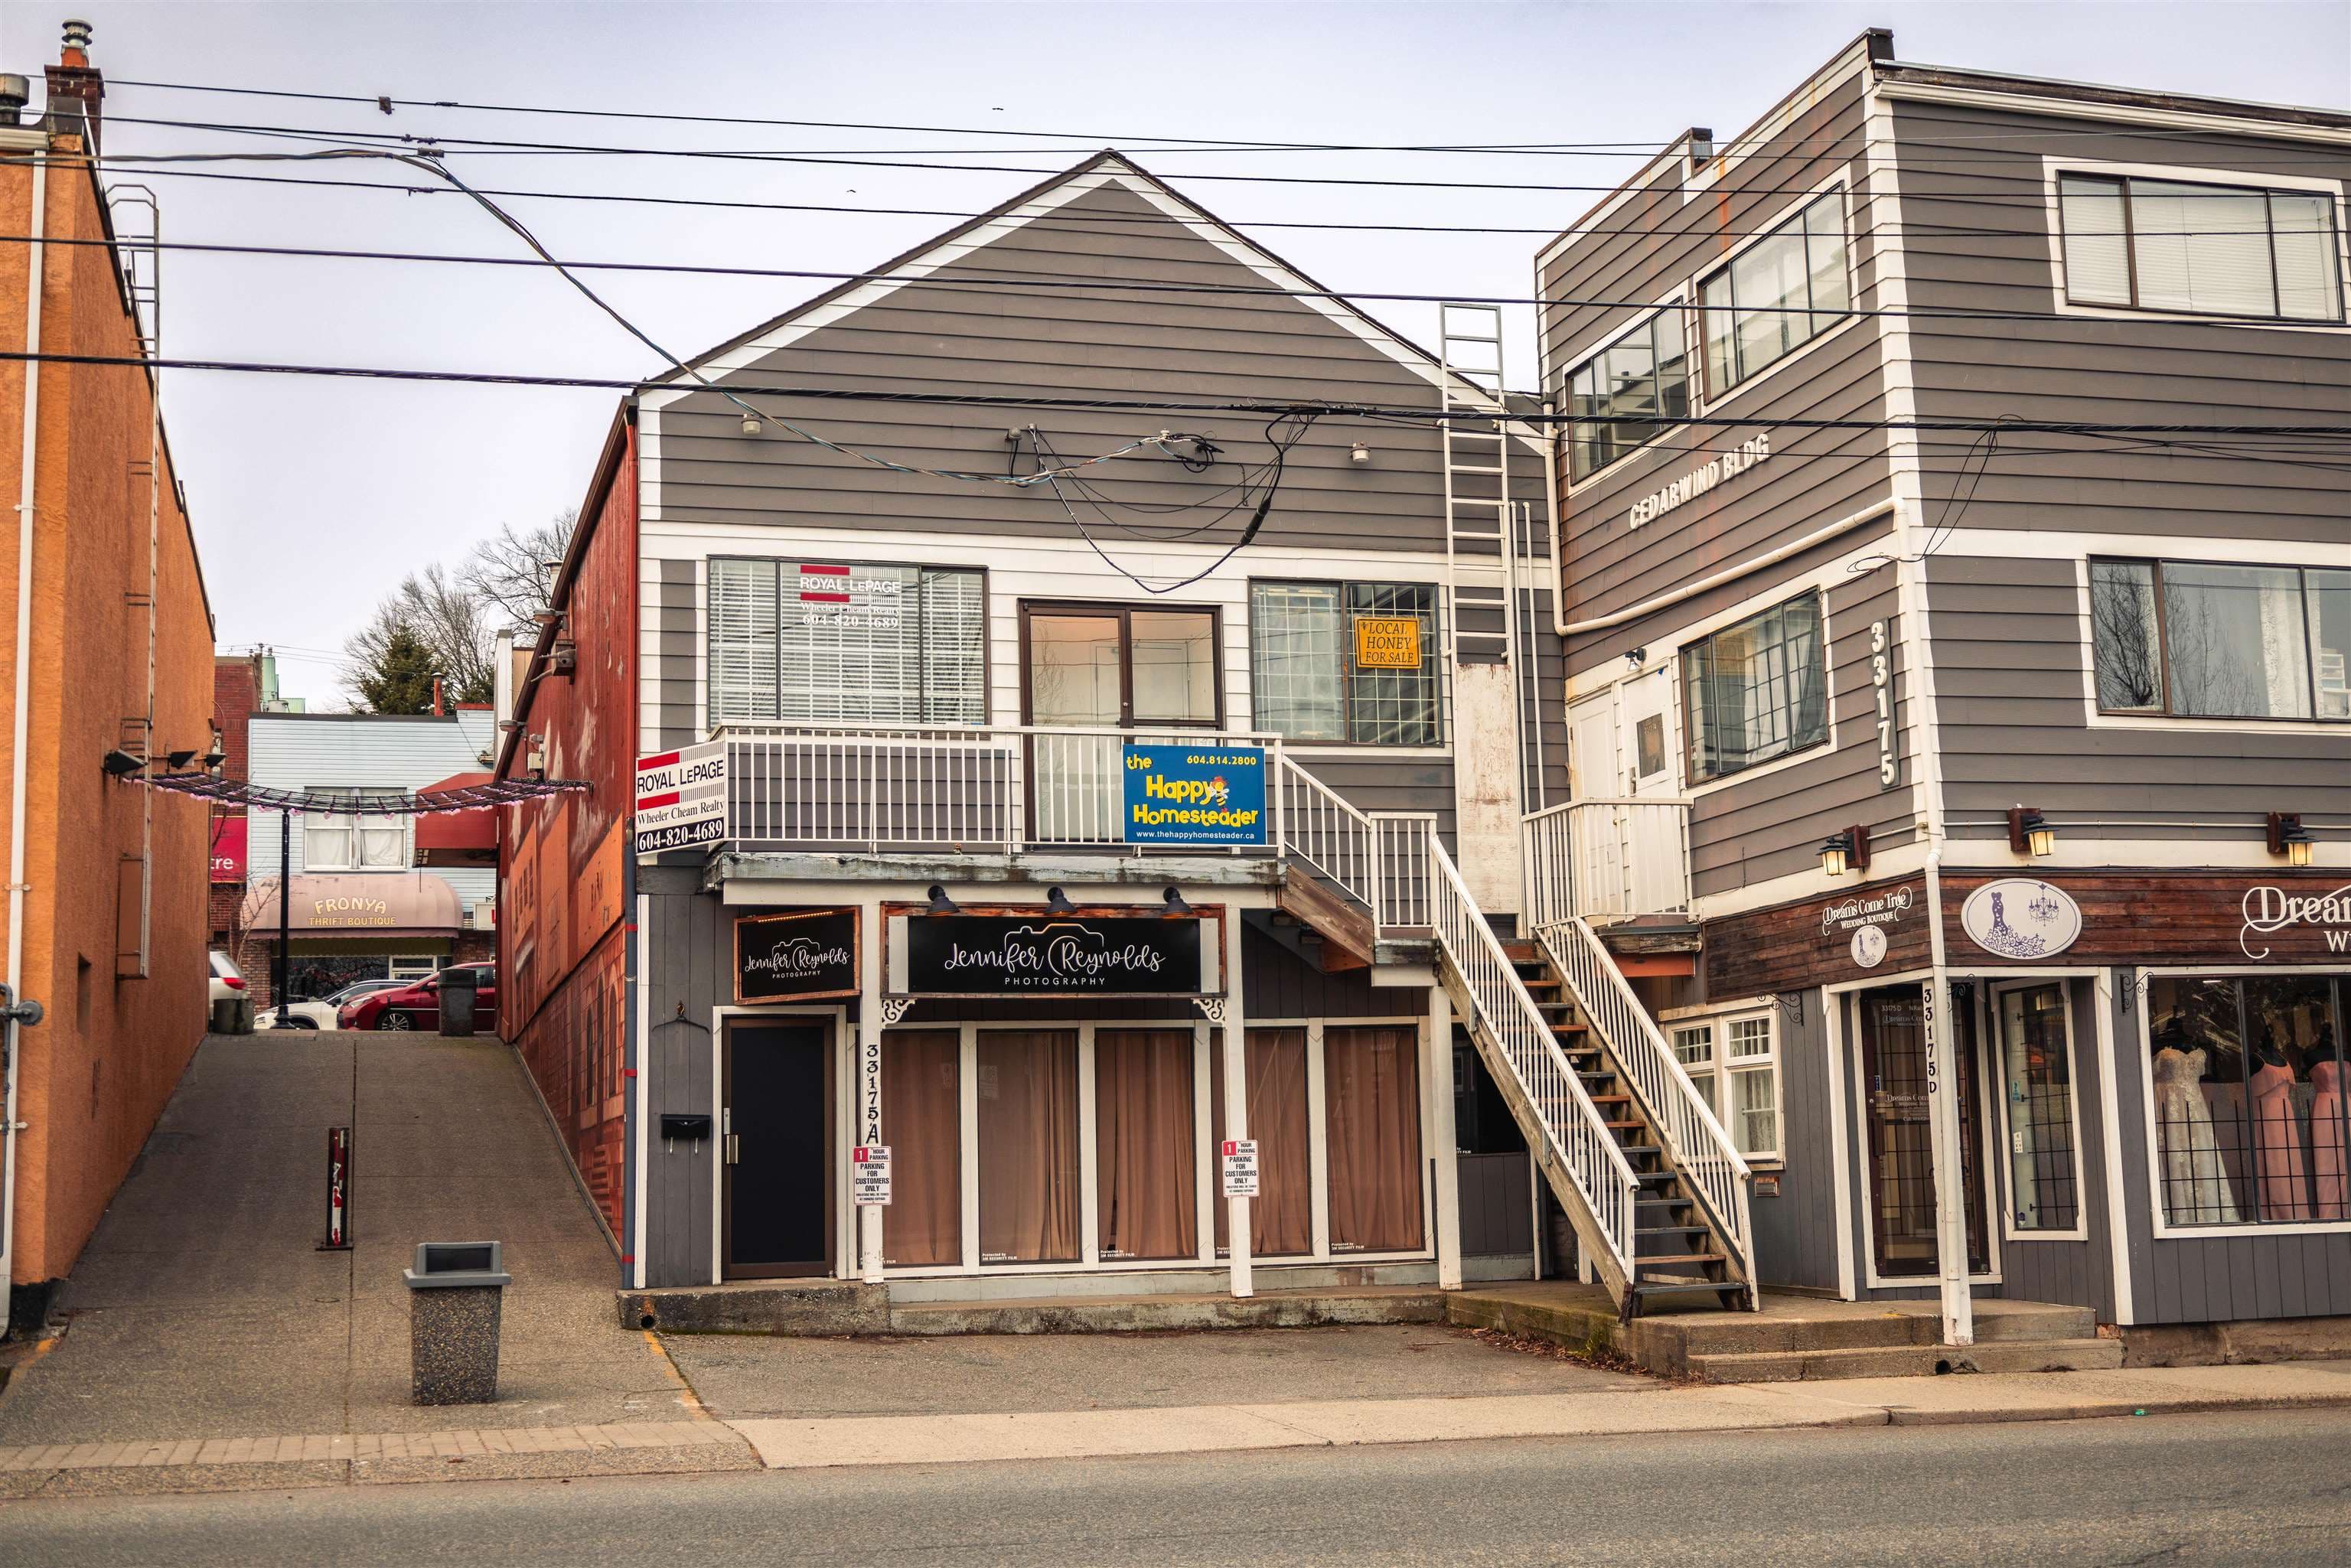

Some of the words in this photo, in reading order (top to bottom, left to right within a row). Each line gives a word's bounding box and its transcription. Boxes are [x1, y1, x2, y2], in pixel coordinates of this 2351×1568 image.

[1630, 461, 1720, 530] CEDARWIND
[1723, 434, 1769, 481] BLDG
[800, 577, 844, 591] ROYAL
[801, 602, 836, 612] Wheeler
[840, 604, 869, 613] Cheam
[874, 605, 899, 618] Realty
[802, 614, 898, 628] 604-820-4689
[1369, 622, 1407, 634] LOCAL
[1366, 636, 1412, 650] HONEY
[1365, 651, 1386, 663] FOR
[1388, 652, 1414, 663] SALE
[1871, 621, 1895, 785] 33175
[1127, 754, 1153, 770] the
[1187, 755, 1257, 765] 604.814.2800
[637, 771, 675, 794] ROYAL
[1146, 774, 1214, 806] Happy
[637, 811, 669, 825] Wheeler
[670, 804, 698, 820] Cheam
[700, 799, 724, 813] Realty
[1133, 804, 1259, 828] Homesteader
[638, 819, 723, 851] 604-820-4689
[1136, 830, 1255, 840] www.thehappyhomesteader.ca
[210, 857, 233, 870] re
[315, 897, 386, 914] FRONYA
[1823, 899, 1858, 925] Dreams
[1858, 899, 1884, 914] Come
[1884, 887, 1912, 909] True
[308, 917, 344, 926] THRIFT
[347, 917, 397, 926] BOUTIQUE
[1841, 917, 1867, 930] WEDDING
[1867, 911, 1894, 924] BOUTIQUE
[2323, 931, 2351, 953] W
[745, 953, 791, 973] Jennifer
[797, 947, 850, 970] Reynolds
[944, 943, 1044, 973] Jennifer
[1059, 941, 1166, 975] Reynolds
[772, 970, 821, 979] PHOTOGRAPHY
[1005, 977, 1106, 986] PHOTOGRAPHY
[1924, 989, 1938, 1094] 33175D
[866, 1044, 879, 1144] 33175A
[858, 1150, 863, 1160] 1
[1228, 1143, 1232, 1154] 1
